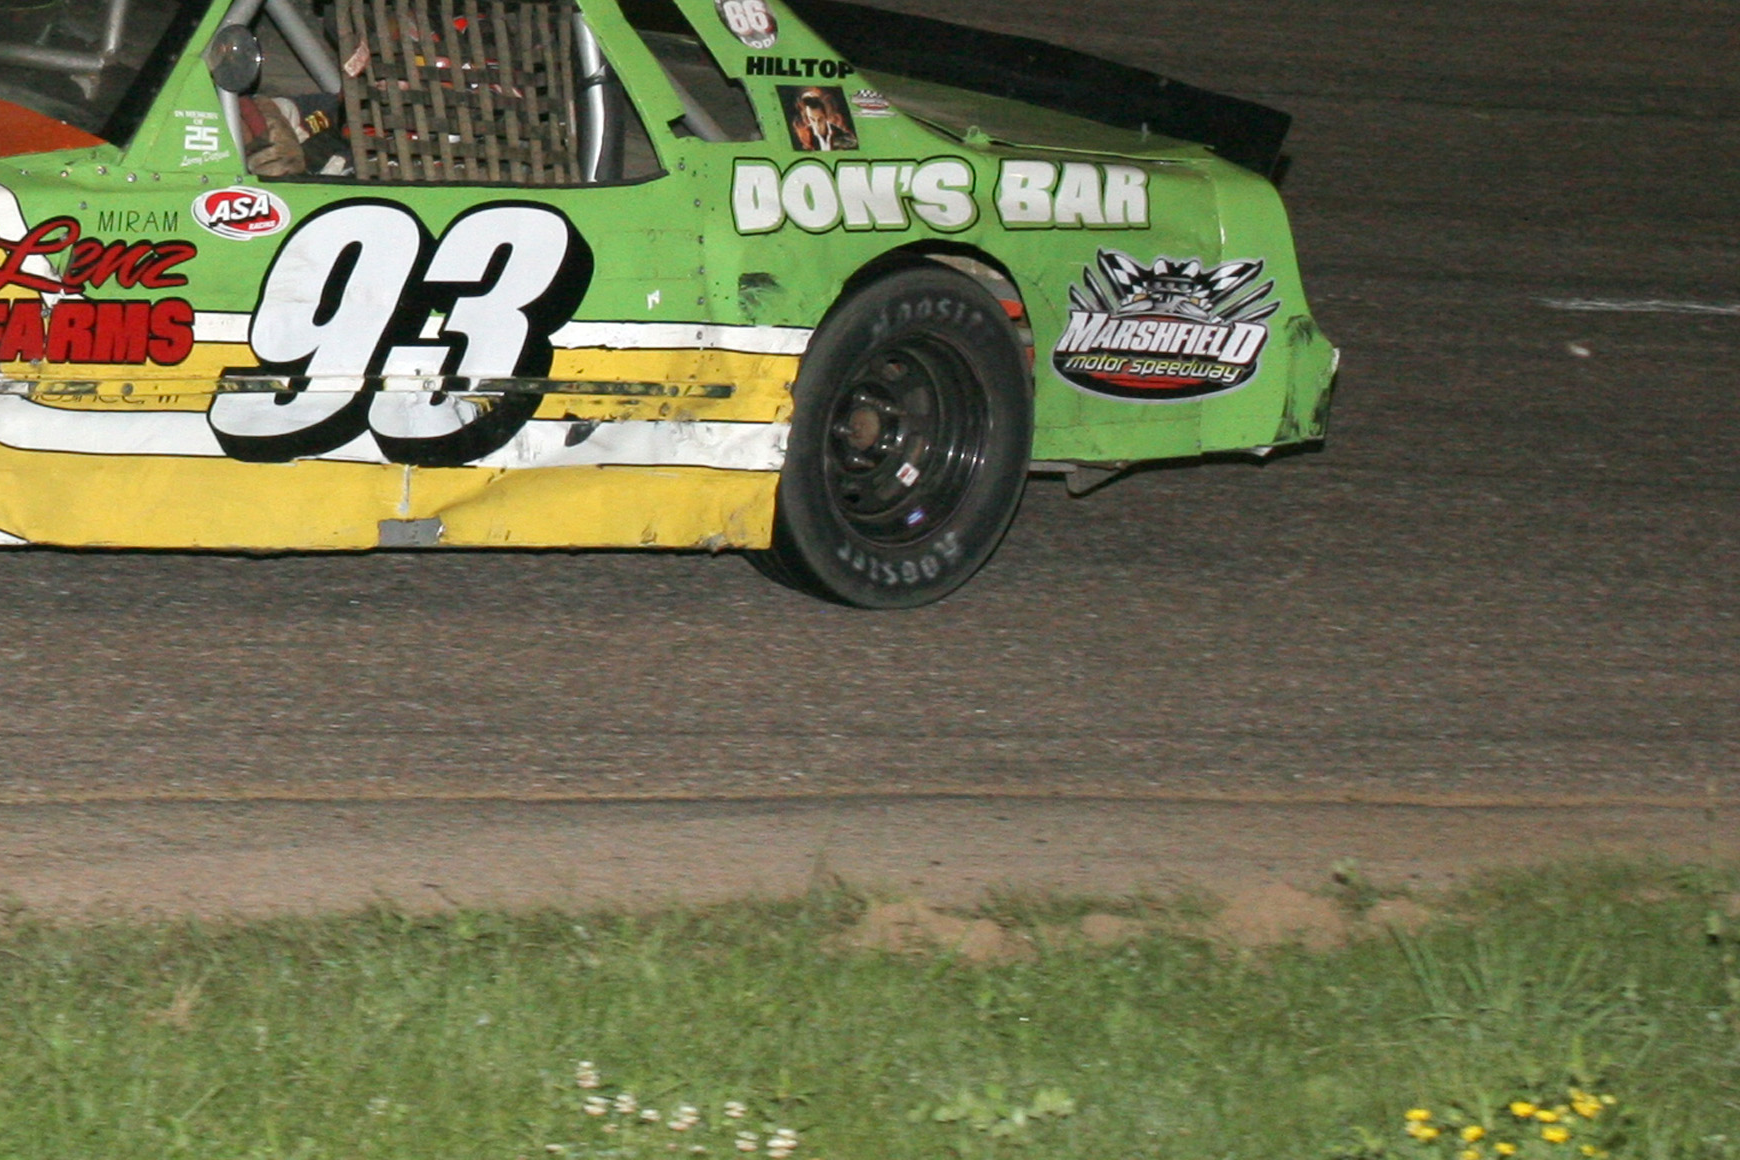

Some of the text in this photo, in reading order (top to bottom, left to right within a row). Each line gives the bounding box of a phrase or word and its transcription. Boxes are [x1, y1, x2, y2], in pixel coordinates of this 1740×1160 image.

[746, 55, 856, 79] HILLTOP
[184, 125, 219, 151] 25
[209, 193, 270, 227] ASA
[732, 156, 1151, 235] DON'S BAR
[97, 210, 179, 233] MIRAM
[207, 197, 594, 464] 93
[1055, 310, 1268, 365] MARSHFIELD
[1065, 354, 1243, 384] motor speedway
